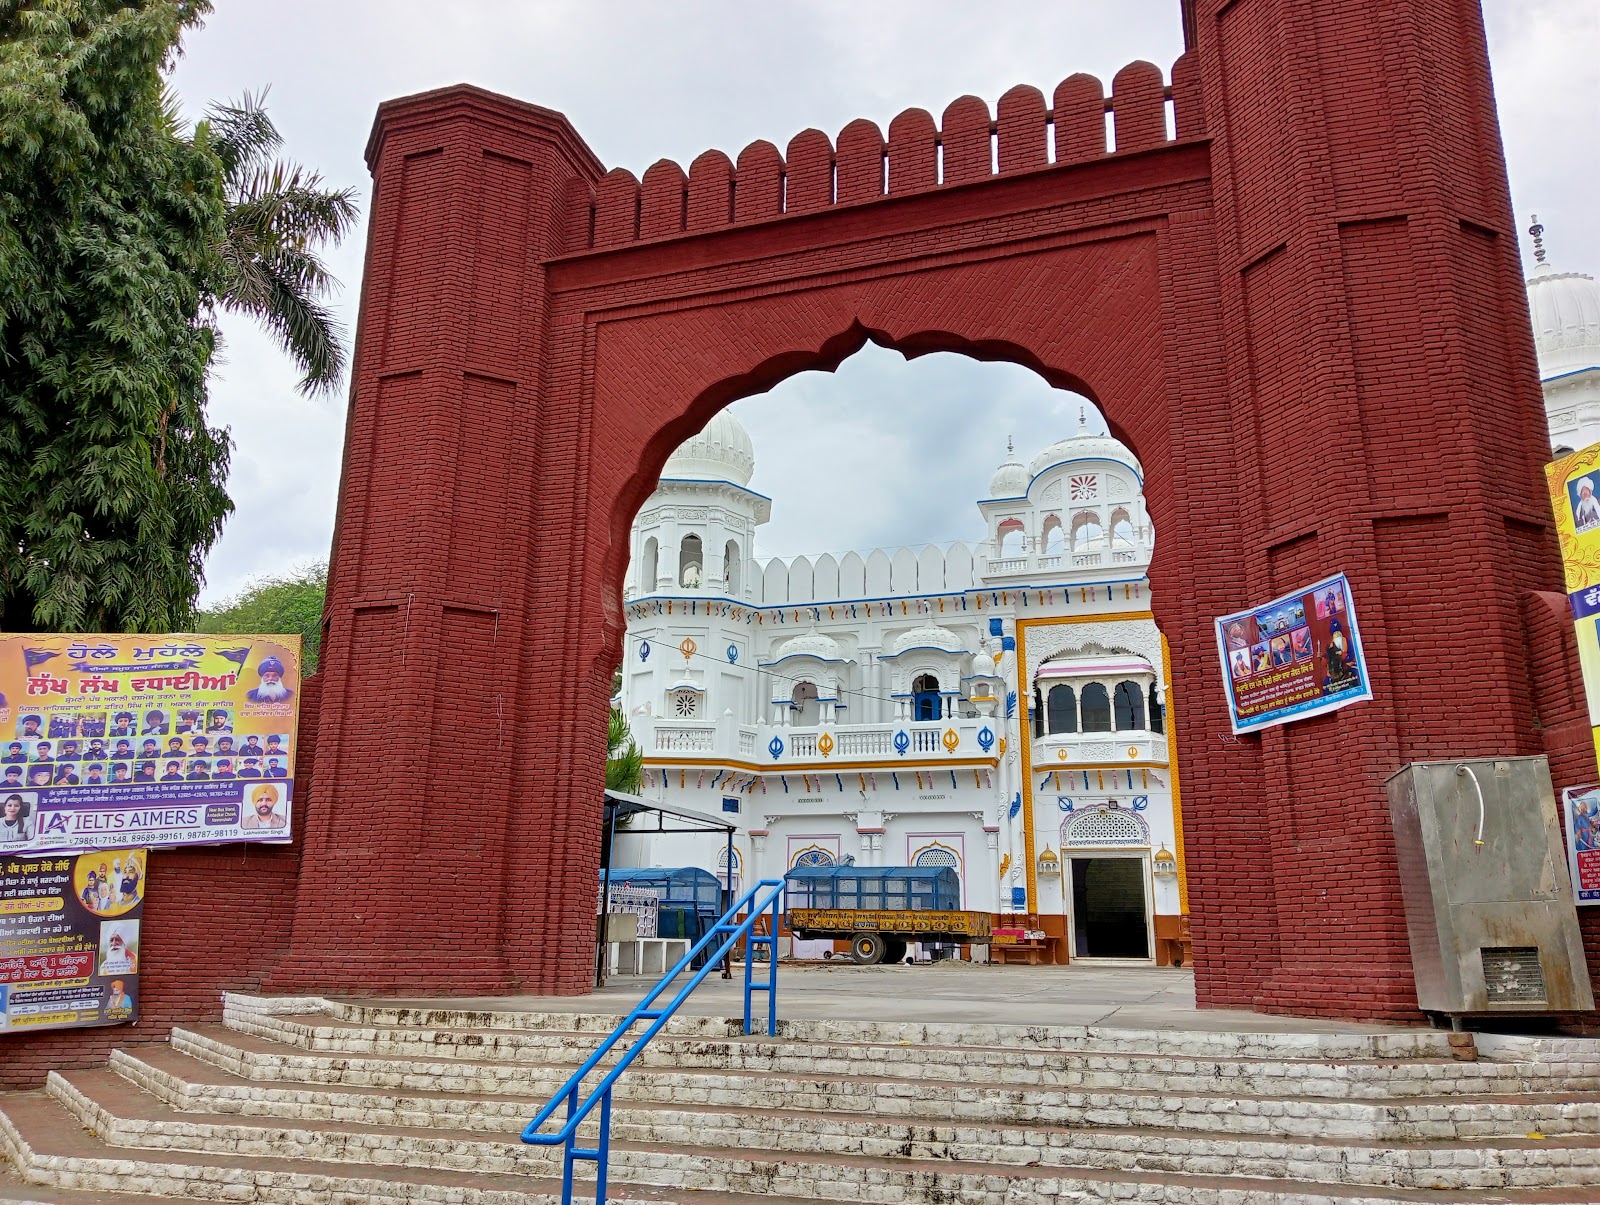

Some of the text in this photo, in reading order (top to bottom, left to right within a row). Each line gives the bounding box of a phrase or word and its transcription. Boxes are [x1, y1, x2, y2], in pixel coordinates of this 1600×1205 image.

[67, 644, 118, 659] ਹੋਲੇ
[28, 670, 236, 694] ਲੱਖ ਲੱਖ ਵਧਾਈਆਂ
[75, 810, 198, 830] IELTS AIMERS
[74, 836, 129, 845] 79861-71548,
[132, 833, 185, 842] 89689-99161,
[188, 829, 238, 839] 98787-98119
[51, 958, 56, 966] 1
